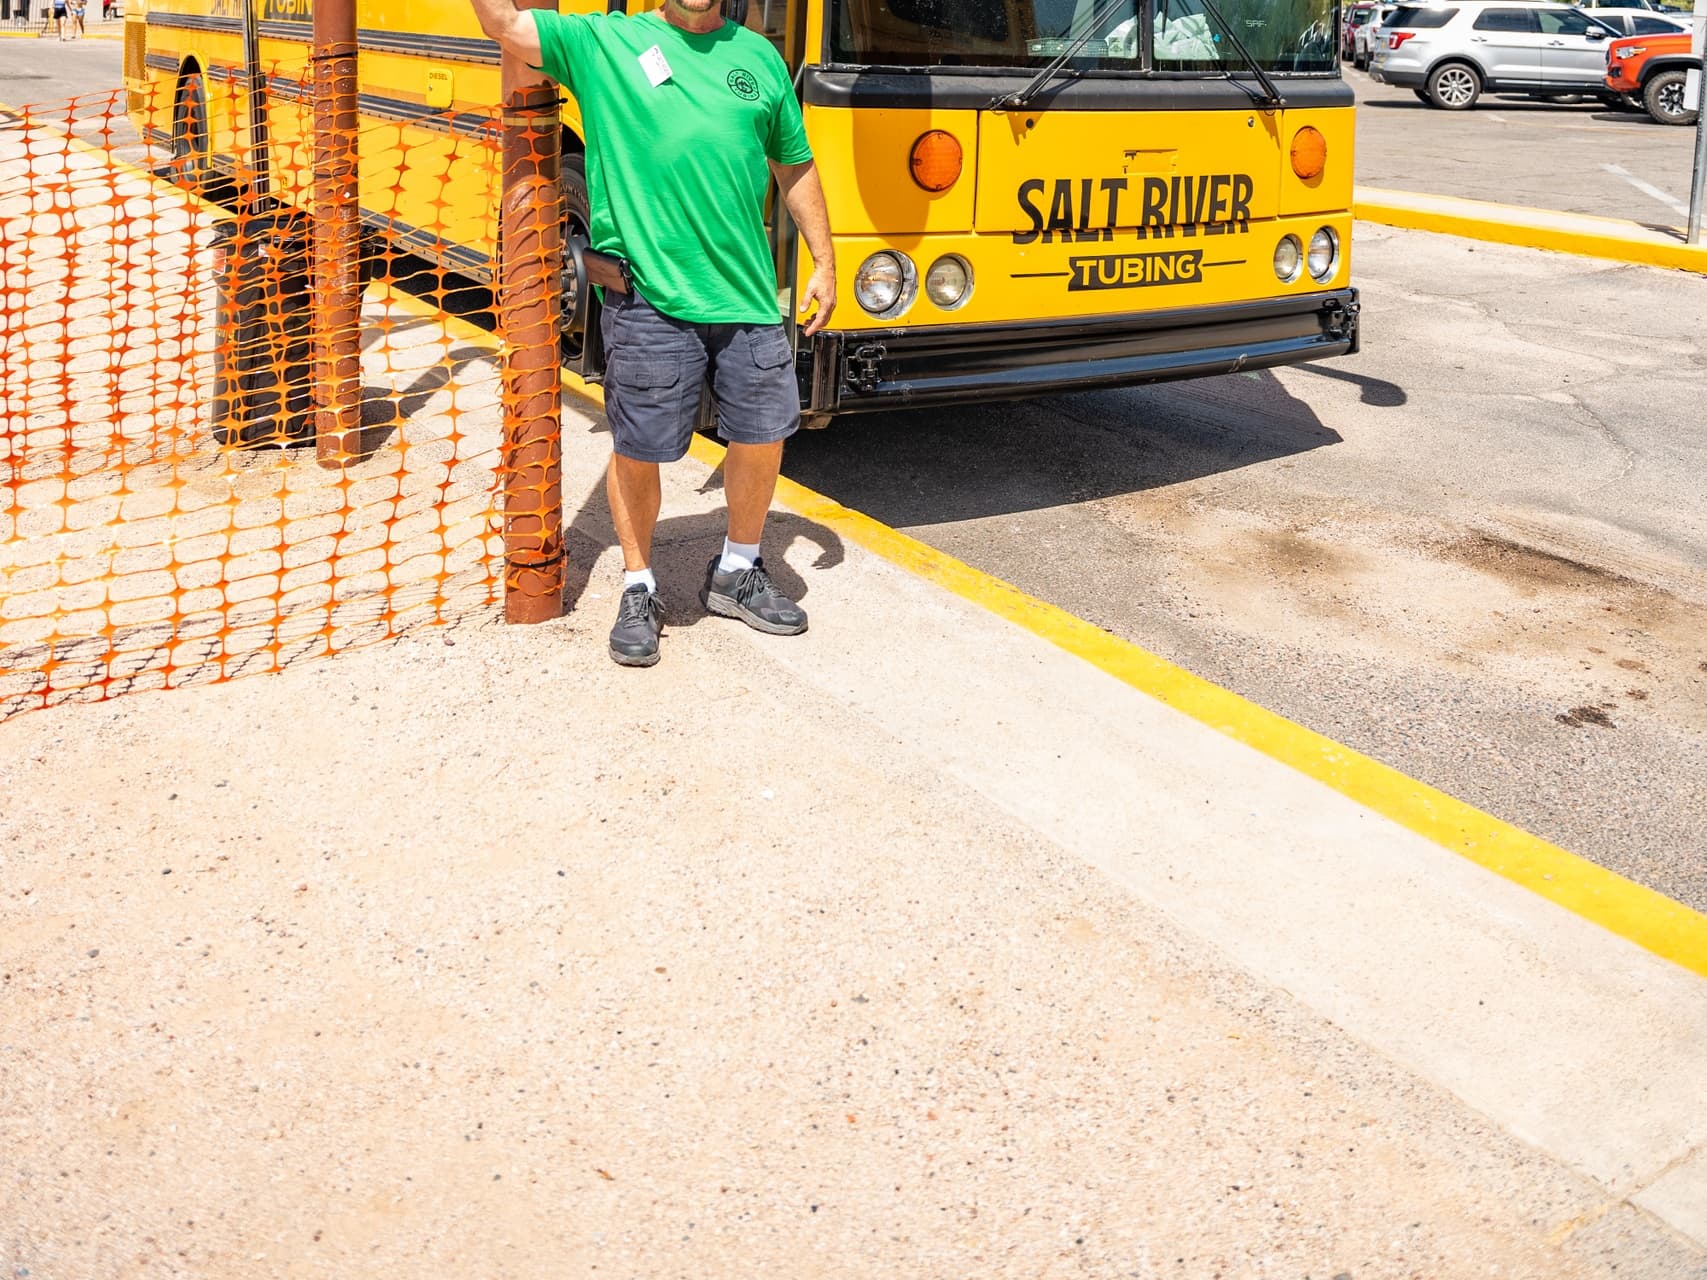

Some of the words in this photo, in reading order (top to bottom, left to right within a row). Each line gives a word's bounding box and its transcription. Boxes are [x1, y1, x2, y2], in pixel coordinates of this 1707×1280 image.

[1012, 178, 1128, 245] SALT
[1137, 174, 1254, 240] RIVER
[1076, 254, 1195, 286] TUBING
